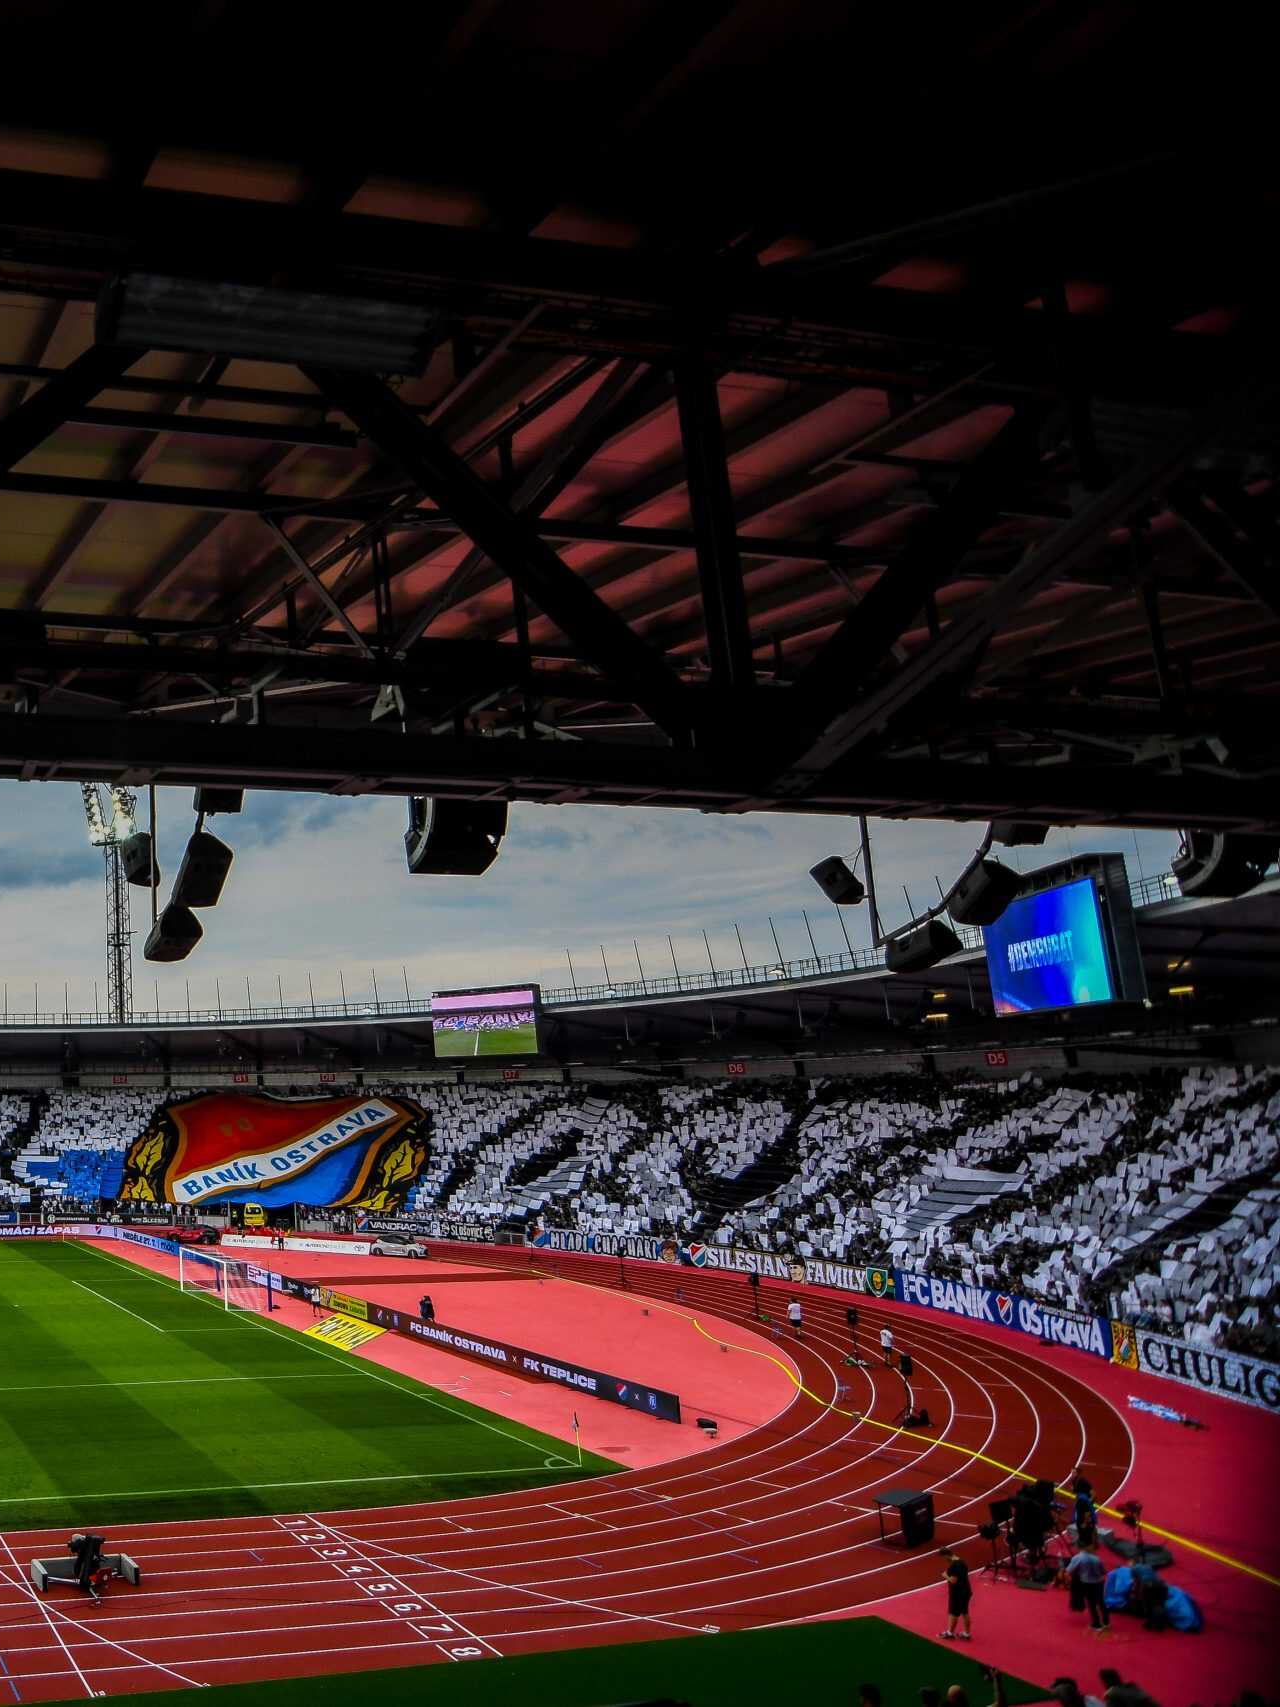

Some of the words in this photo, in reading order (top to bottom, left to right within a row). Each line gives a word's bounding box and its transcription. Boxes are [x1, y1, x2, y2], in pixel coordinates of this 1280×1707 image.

[987, 1053, 1006, 1065] D5
[728, 1063, 743, 1073] D6
[182, 1161, 267, 1197] BANÍK
[270, 1106, 386, 1172] OSTRAVA
[37, 1225, 81, 1234] ZÁPAS
[707, 1247, 789, 1278] SILESIAN
[806, 1262, 866, 1292] FAMILY
[902, 1273, 929, 1305] FC
[930, 1279, 995, 1322] BANIK
[409, 1321, 422, 1334] FC
[422, 1325, 454, 1345] BANÍK
[454, 1336, 507, 1361] OSTRAVA
[523, 1357, 540, 1373] FK
[540, 1362, 597, 1391] TEPLICE
[284, 1519, 307, 1527] 1
[322, 1548, 348, 1556] 3
[347, 1565, 373, 1574] 4
[368, 1583, 398, 1592] 5
[393, 1602, 422, 1612] 6
[420, 1623, 454, 1632] 7
[451, 1646, 482, 1657] 8
